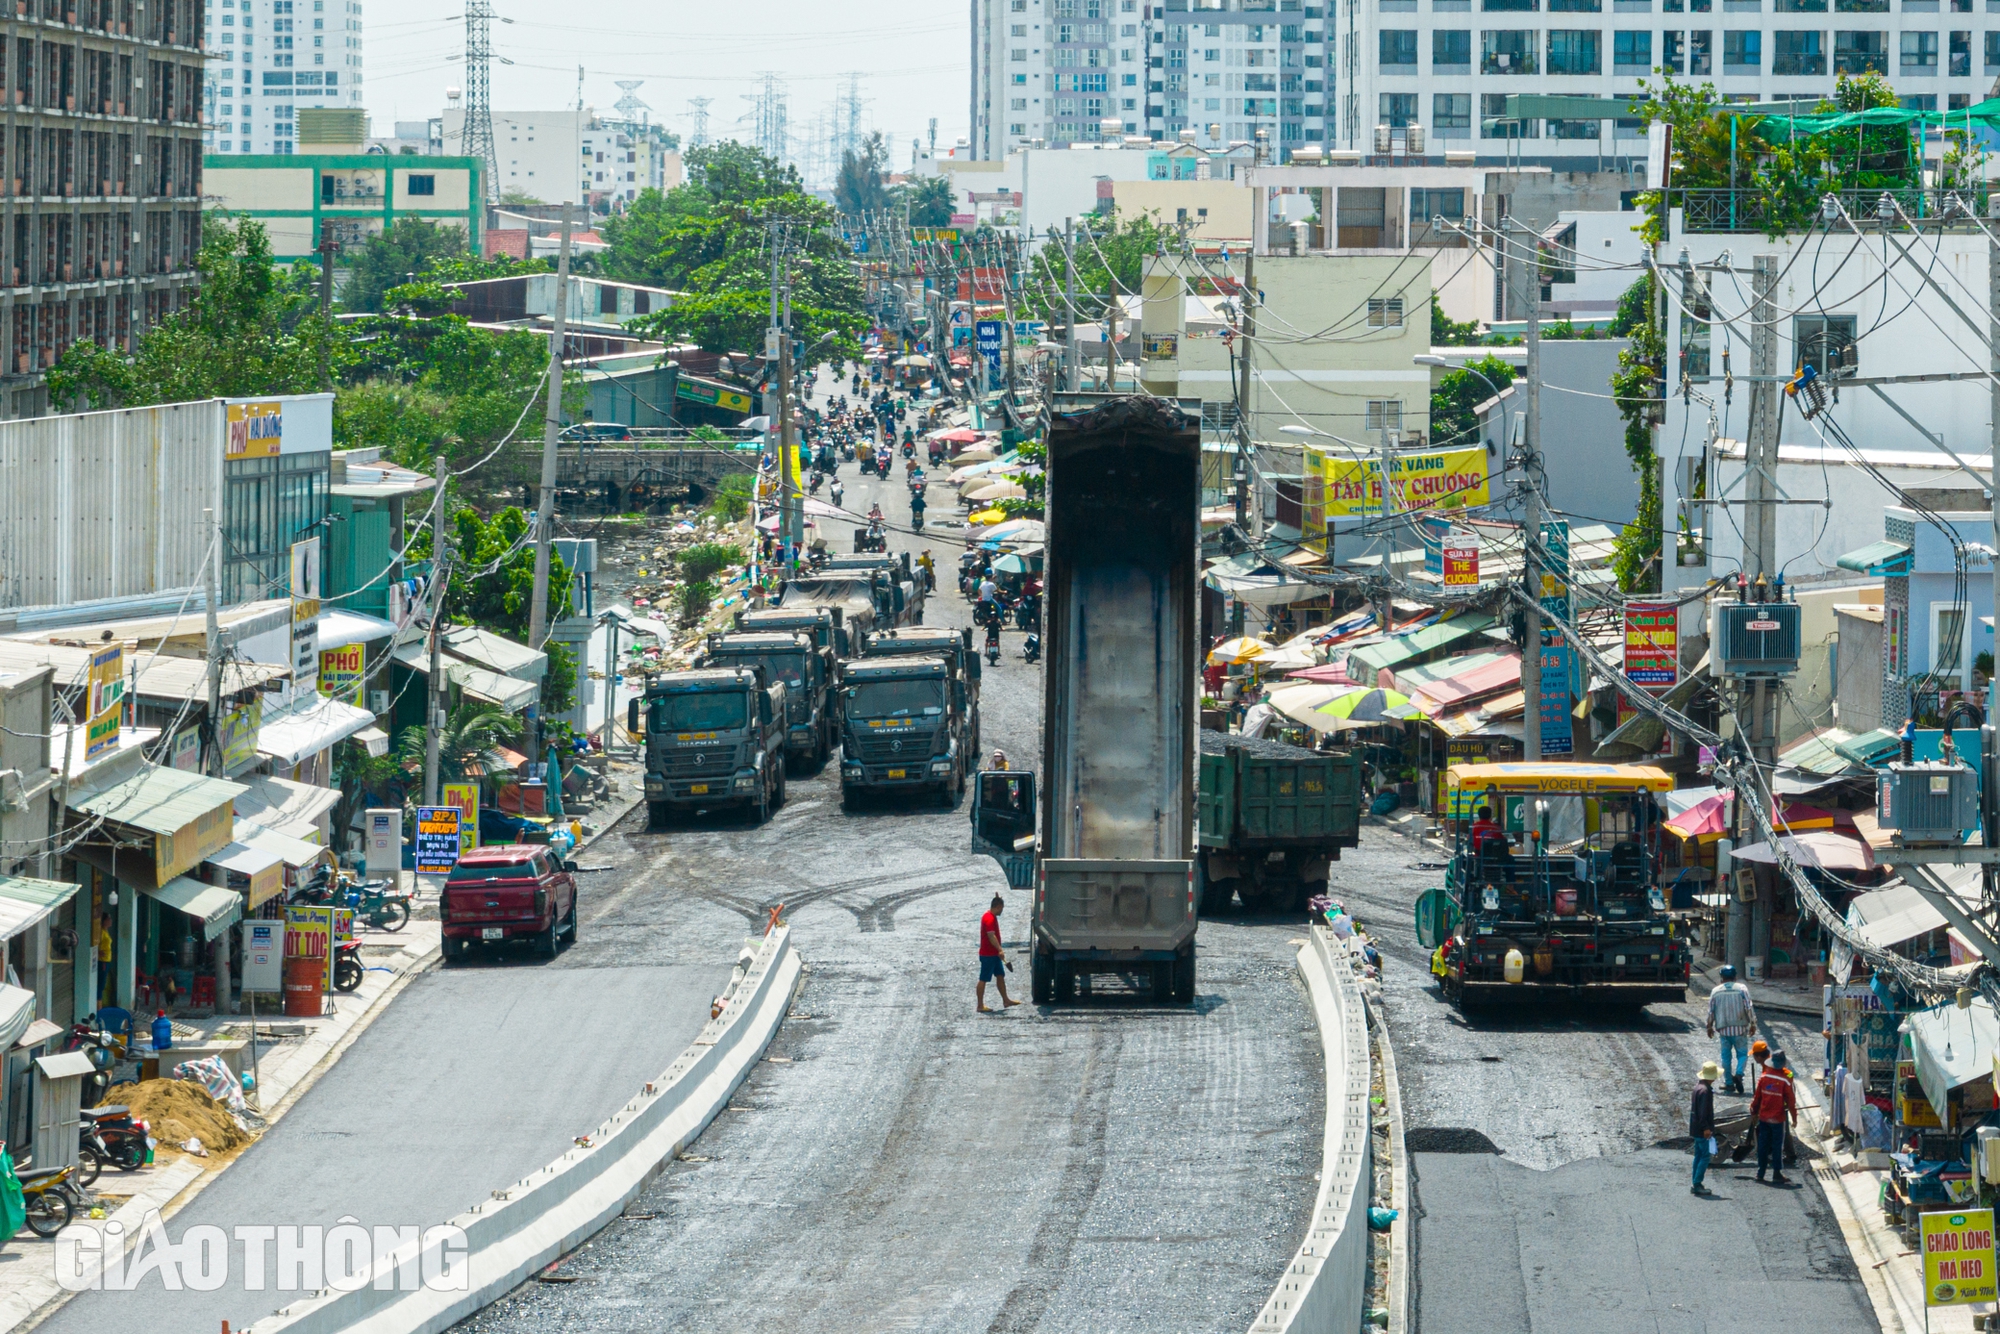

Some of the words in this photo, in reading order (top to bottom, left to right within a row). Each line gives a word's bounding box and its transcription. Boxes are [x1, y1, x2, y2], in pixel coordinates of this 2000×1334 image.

[981, 325, 995, 336] NHÀ
[1406, 456, 1444, 472] VÀNG
[1331, 477, 1363, 500] TÂN
[1411, 472, 1481, 496] CHƯƠNG
[1464, 550, 1473, 558] XE
[325, 646, 360, 671] PHỞ
[1550, 656, 1560, 667] 35
[323, 671, 335, 681] HẢI
[677, 740, 720, 748] SHACMAN
[447, 786, 475, 819] Phở
[432, 811, 457, 821] SPA
[304, 928, 328, 959] TÓC
[1927, 1229, 1959, 1253] CHÁO
[1961, 1228, 1991, 1251] LÒNG
[1939, 1258, 1958, 1280] MÁ
[1960, 1259, 1982, 1279] HEO
